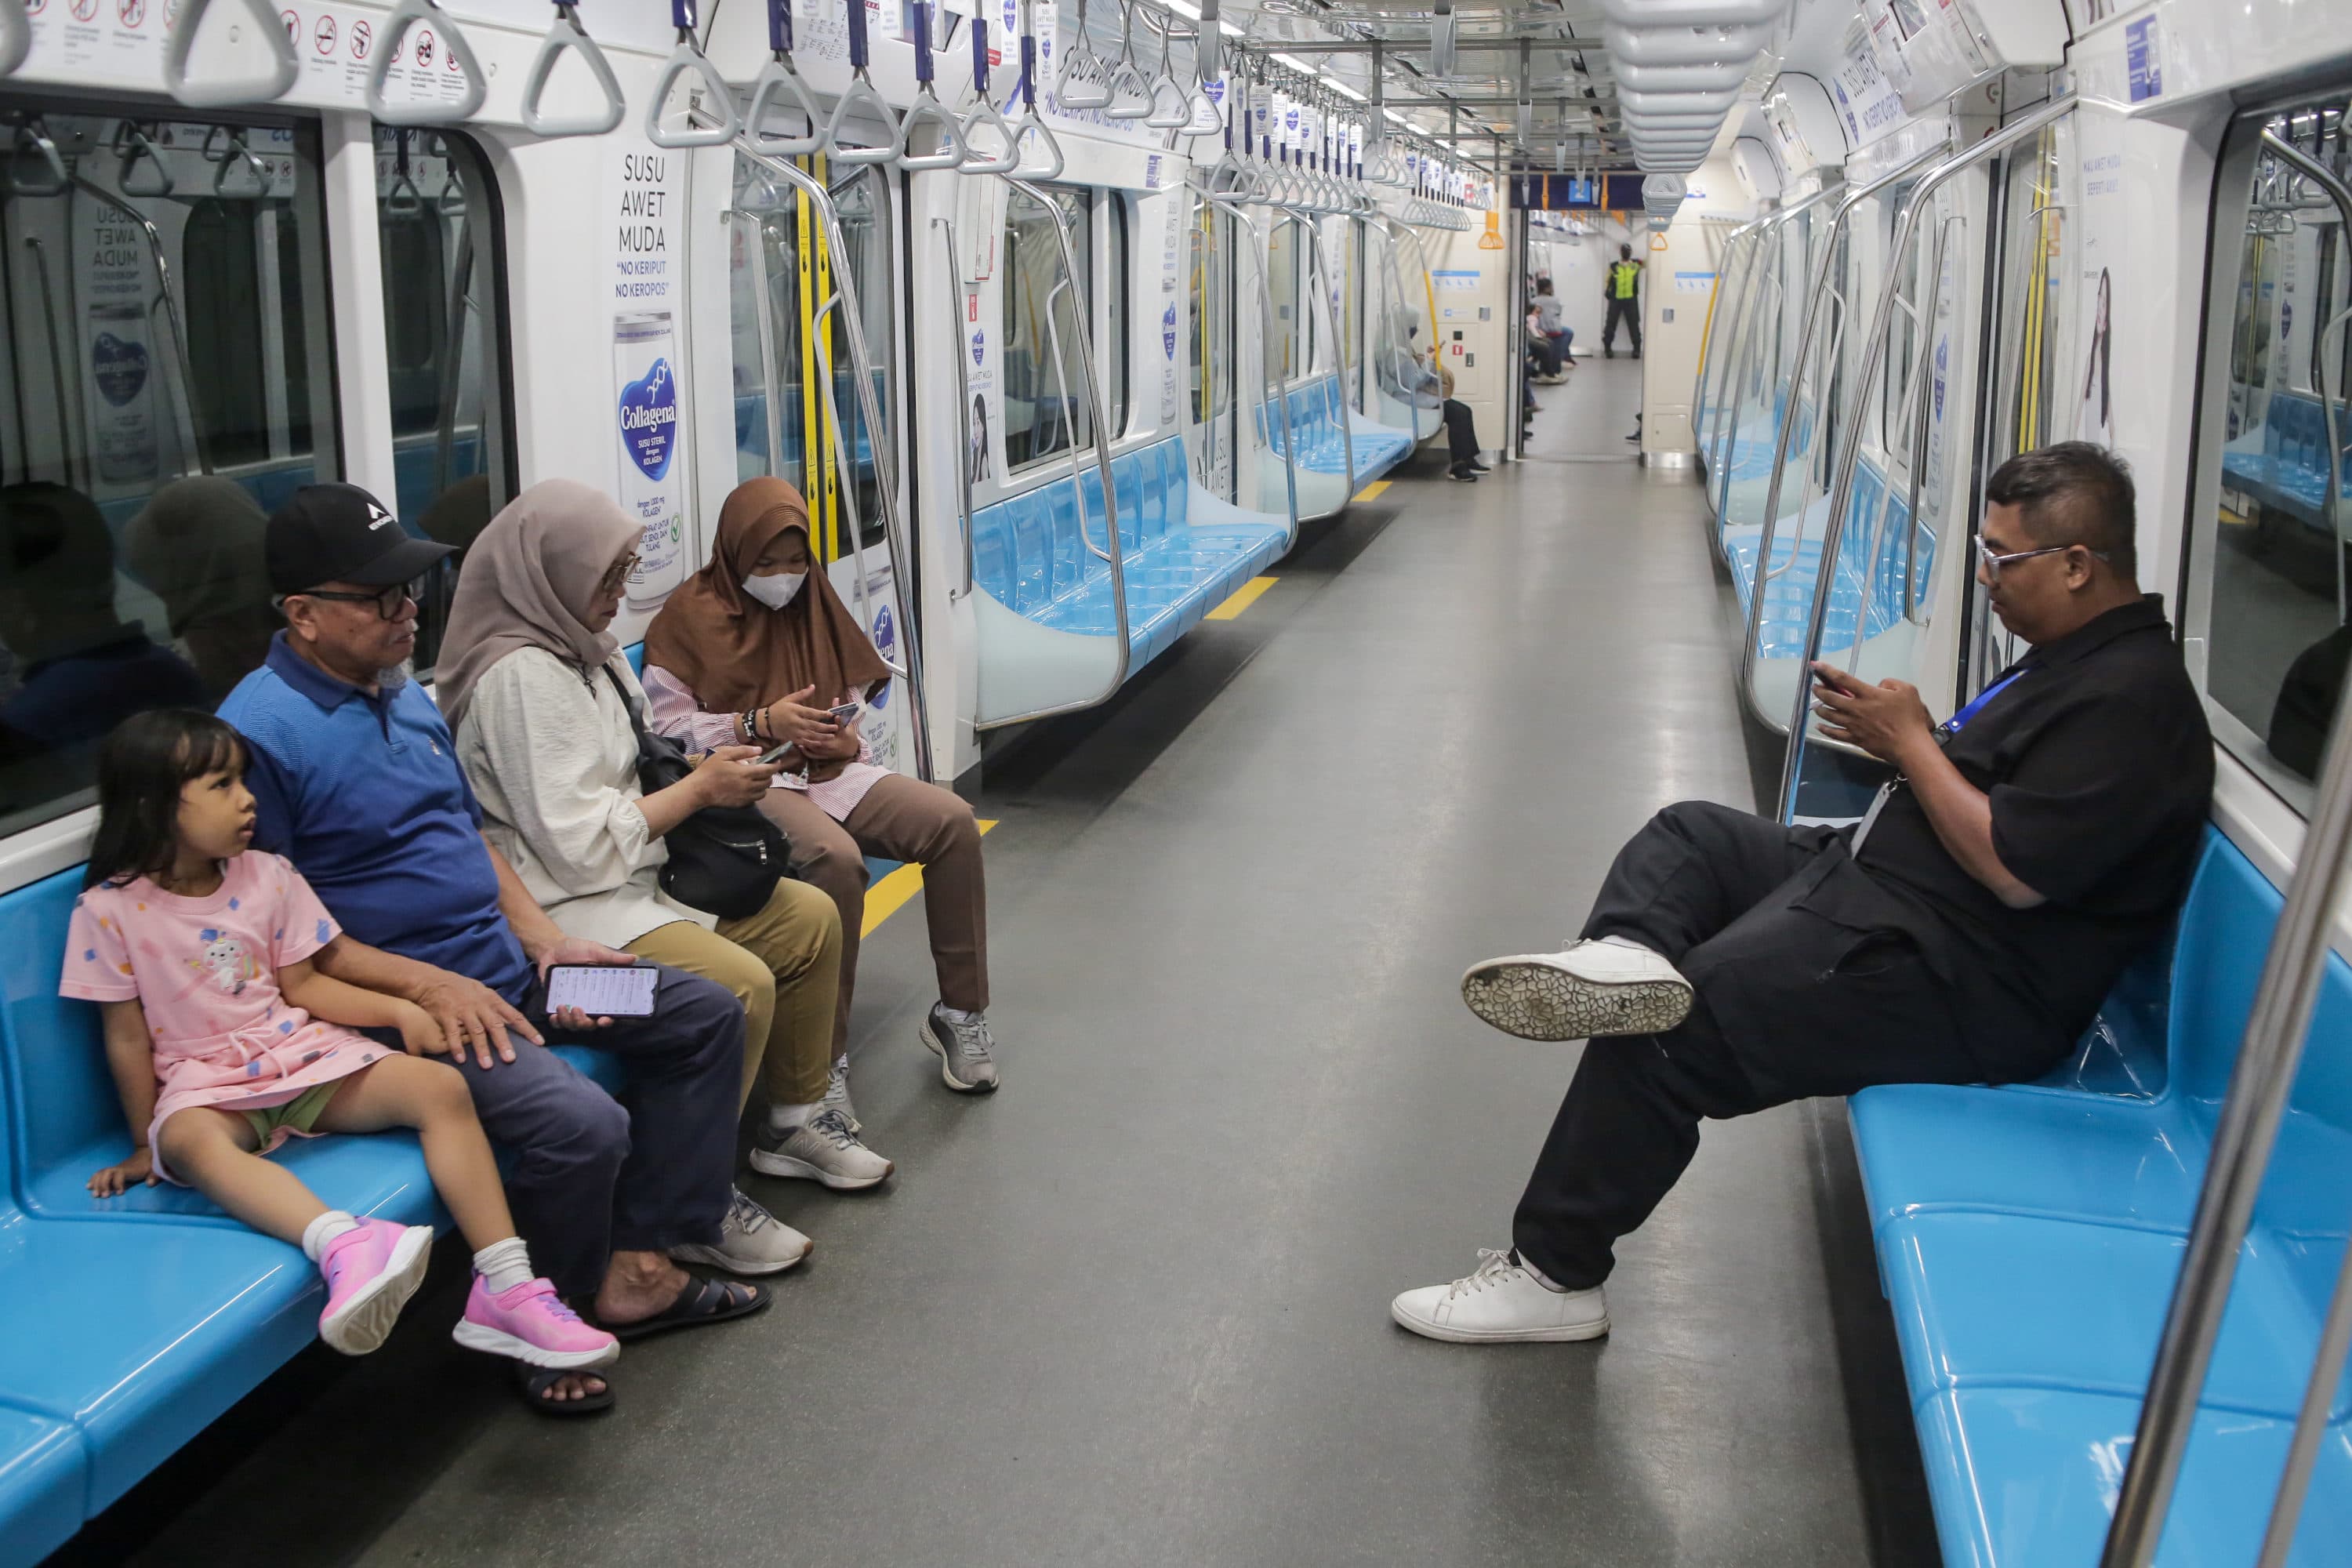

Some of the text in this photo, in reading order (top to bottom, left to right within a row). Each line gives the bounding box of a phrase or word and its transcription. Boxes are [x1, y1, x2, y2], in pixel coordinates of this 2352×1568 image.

[624, 154, 665, 183] SUSU
[620, 191, 666, 217] AWET
[619, 225, 666, 252] MUDA
[634, 260, 666, 274] KERIPUT
[615, 284, 628, 298] NO
[620, 405, 676, 433] Collagena
